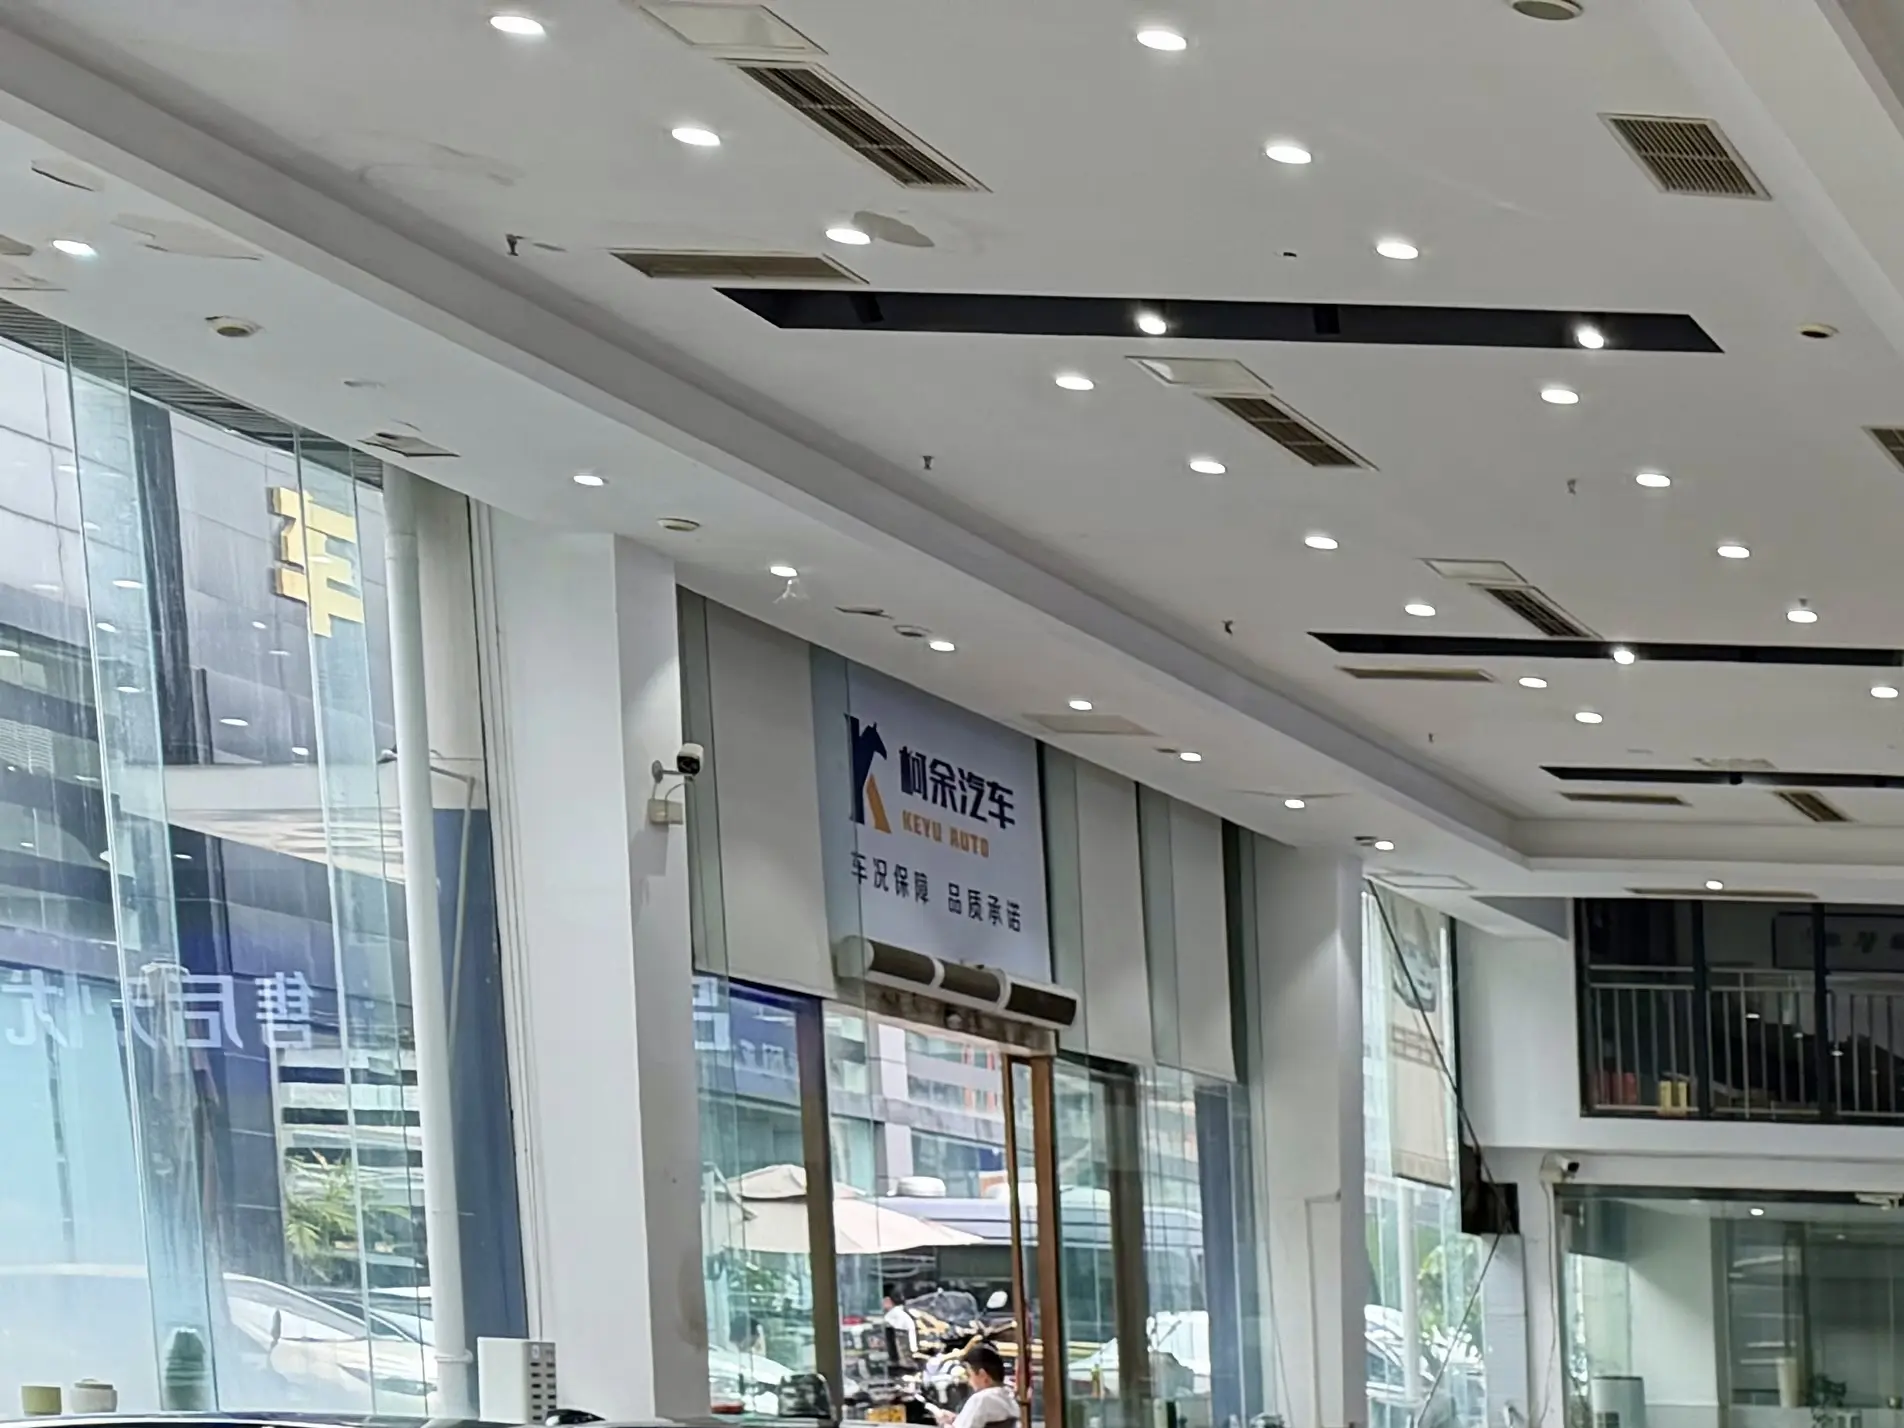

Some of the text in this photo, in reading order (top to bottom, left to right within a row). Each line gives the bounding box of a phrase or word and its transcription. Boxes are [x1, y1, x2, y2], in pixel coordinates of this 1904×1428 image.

[899, 745, 1016, 829] 柯余汽车
[902, 810, 989, 858] KEYU AUTO
[850, 851, 1021, 933] 车况保障 品质承诺
